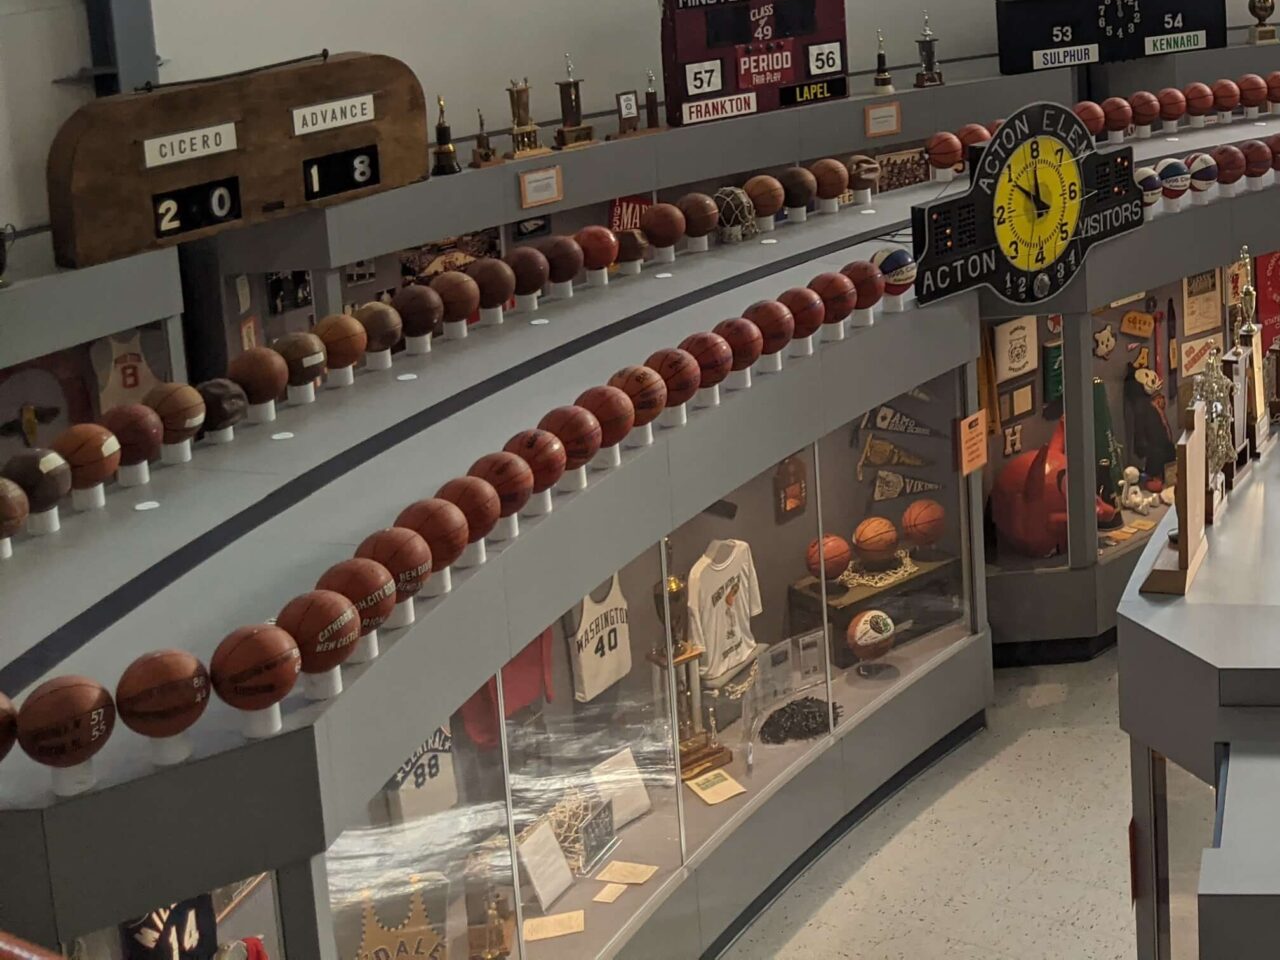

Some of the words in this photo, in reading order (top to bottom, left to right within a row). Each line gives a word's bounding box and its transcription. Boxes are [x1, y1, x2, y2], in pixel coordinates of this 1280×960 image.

[751, 4, 773, 20] CLASS
[1164, 13, 1183, 28] 54
[754, 26, 772, 40] 49
[1053, 27, 1072, 42] 53
[1153, 35, 1199, 51] KENNARD
[741, 52, 791, 74] PERIOD
[815, 51, 836, 69] 56
[1043, 48, 1090, 65] SULPHUR
[693, 69, 714, 89] 57
[796, 83, 831, 101] LAPEL
[302, 102, 368, 129] ADVANCE
[689, 96, 750, 120] FRANKTON
[159, 131, 222, 159] CICERO
[979, 115, 1029, 194] ACTON
[1030, 140, 1039, 159] 8
[1055, 149, 1064, 167] 7
[310, 164, 319, 192] 1
[352, 154, 371, 183] 8
[1007, 164, 1014, 182] 1
[1069, 182, 1077, 200] 6
[158, 199, 181, 231] 2
[210, 187, 231, 217] 0
[996, 206, 1006, 226] 2
[1079, 200, 1141, 238] VISITORS
[1060, 222, 1069, 241] 5
[1009, 241, 1019, 260] 3
[1035, 249, 1045, 265] 4
[923, 249, 995, 295] ACTON
[1005, 273, 1012, 288] 1
[1018, 277, 1026, 291] 2
[1057, 263, 1064, 277] 3
[1068, 249, 1076, 264] 4
[1004, 425, 1022, 456] H
[316, 641, 335, 652] NEW
[595, 627, 617, 657] 40
[414, 755, 439, 788] 88
